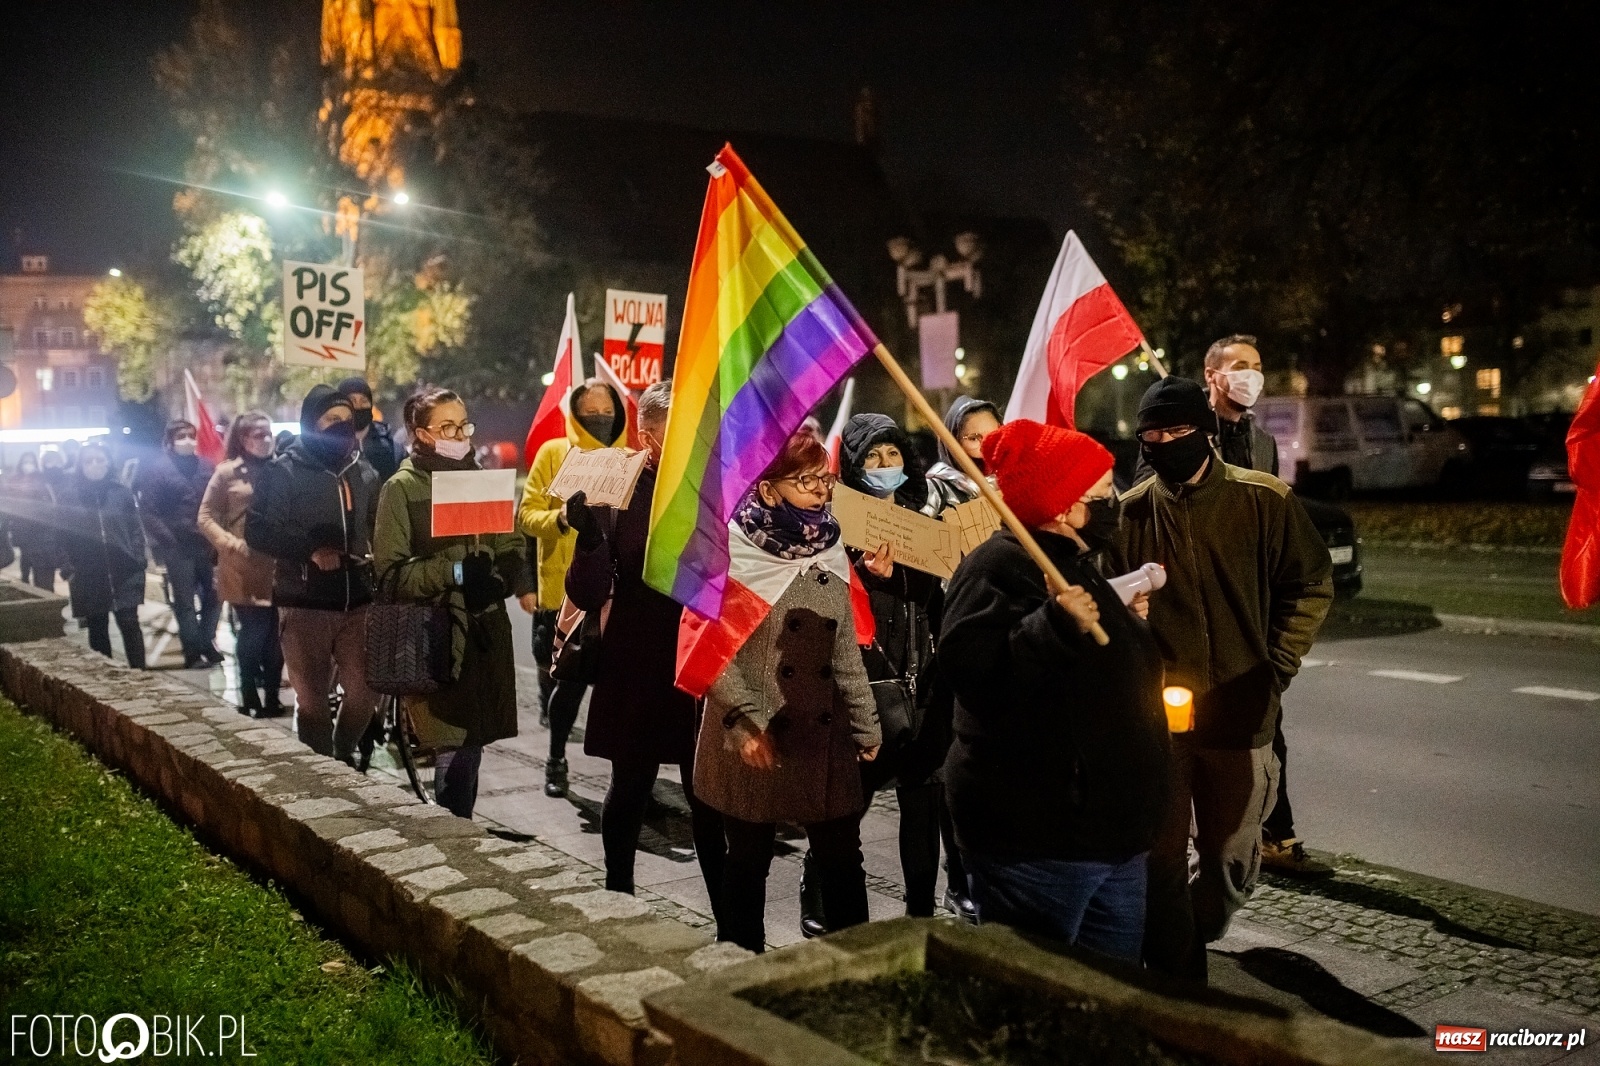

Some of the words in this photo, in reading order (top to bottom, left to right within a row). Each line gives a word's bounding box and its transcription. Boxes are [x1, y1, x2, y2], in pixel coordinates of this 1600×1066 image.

[291, 267, 351, 306] PIS
[290, 305, 363, 347] OFF!
[613, 299, 664, 328] WOLNA
[611, 354, 661, 384] POLKA
